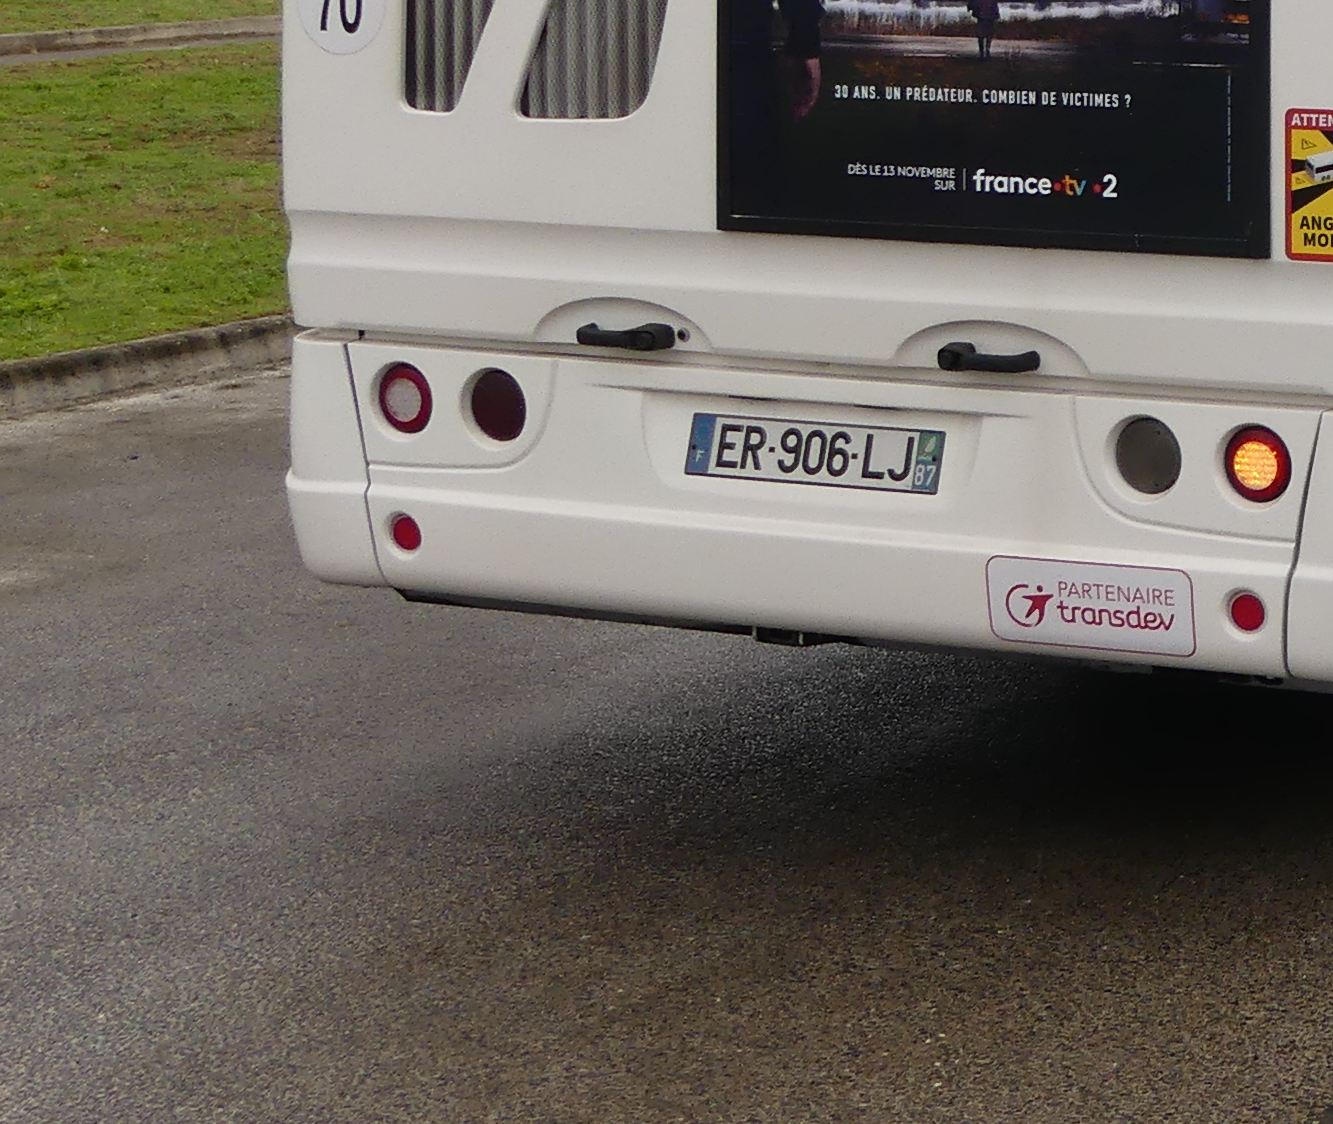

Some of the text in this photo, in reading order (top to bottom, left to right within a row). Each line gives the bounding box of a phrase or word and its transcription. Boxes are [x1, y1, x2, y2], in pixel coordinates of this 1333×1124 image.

[834, 84, 849, 98] 30
[853, 85, 881, 100] ANS.
[885, 86, 901, 101] UN
[905, 84, 977, 103] PRÉDATEUR.
[982, 89, 1037, 105] COMBIEN
[1042, 91, 1057, 106] DE
[1062, 92, 1120, 108] VICTIMES
[847, 162, 956, 178] DÈS LE 13 NOVEMBRE
[934, 180, 956, 191] SUR
[696, 450, 705, 463] F
[914, 463, 937, 487] 87
[1057, 581, 1176, 607] PARTENAIRE
[1056, 600, 1175, 631] transdev
